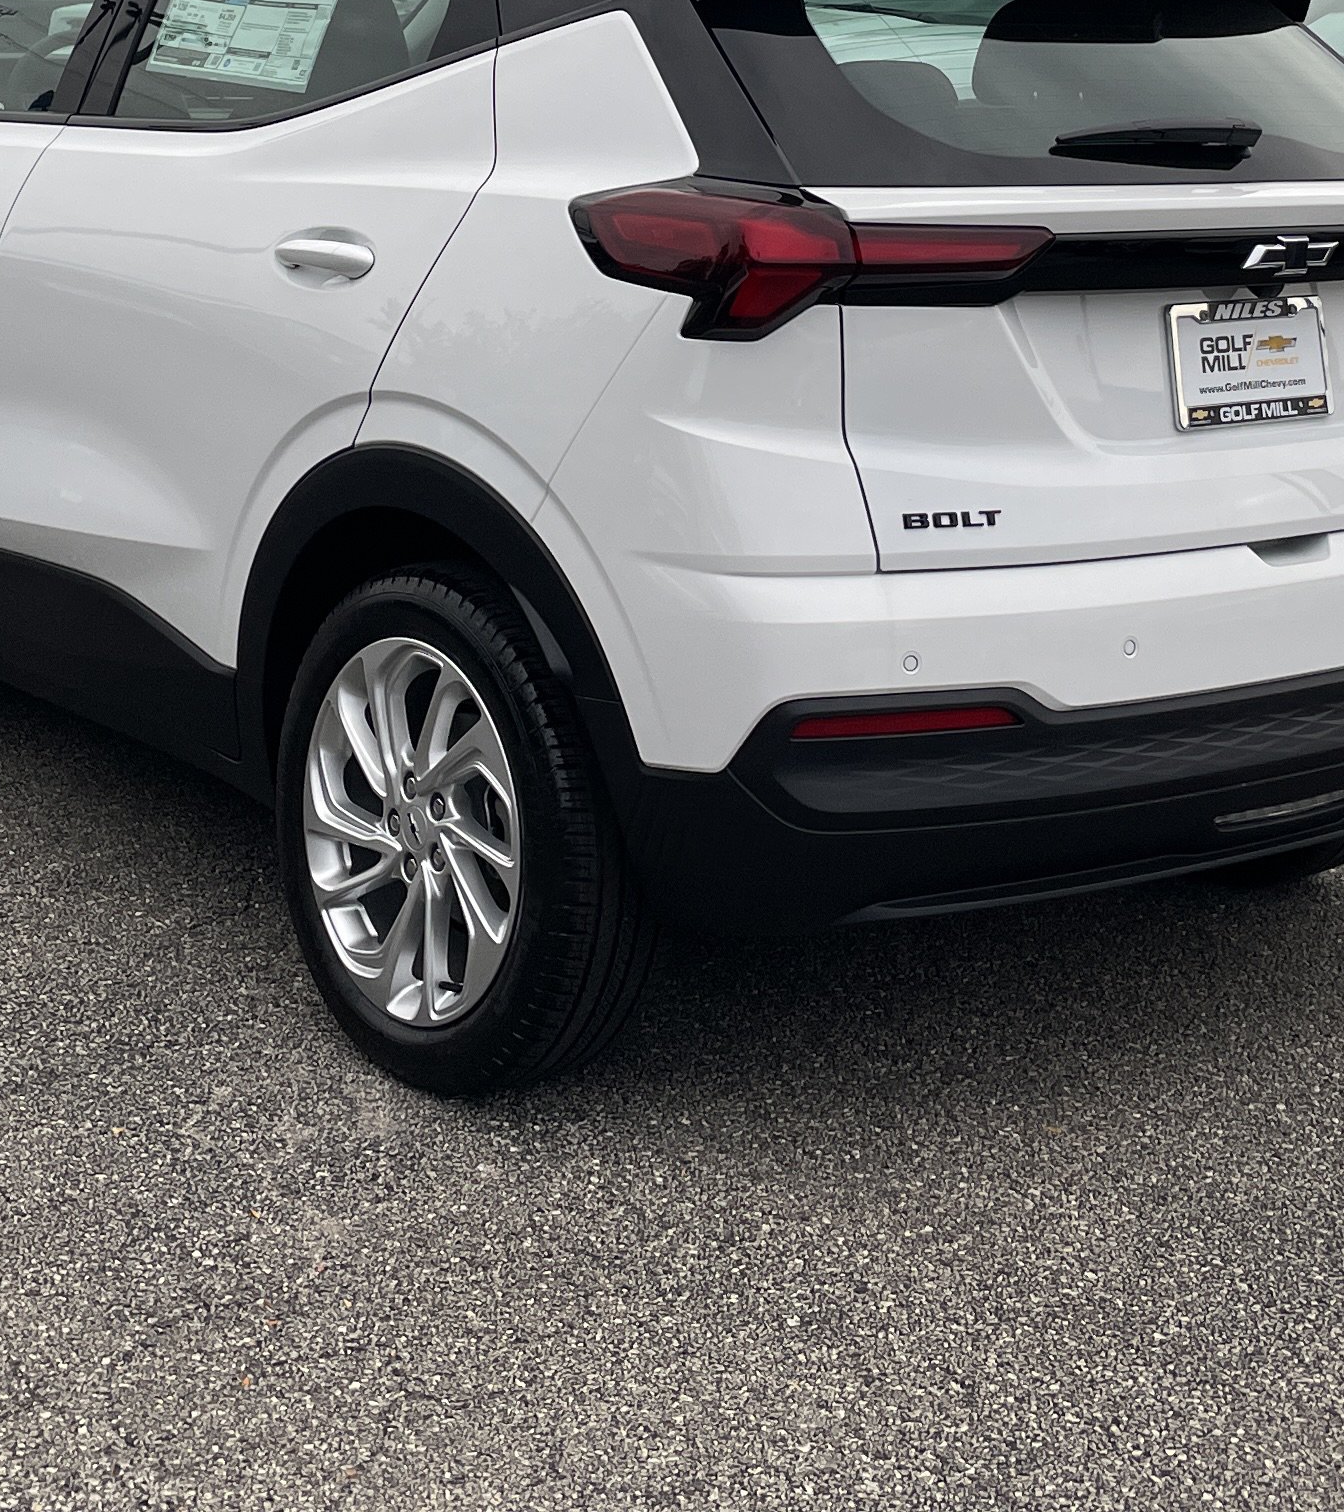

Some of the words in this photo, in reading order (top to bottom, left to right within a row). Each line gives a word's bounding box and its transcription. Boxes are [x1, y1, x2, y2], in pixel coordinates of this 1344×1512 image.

[1214, 300, 1283, 320] NILES
[1200, 334, 1253, 354] GOLF
[1202, 353, 1246, 373] MILL
[1256, 356, 1299, 367] CHEVROLET
[1199, 377, 1306, 394] www.GolfMillChevy.com
[1220, 403, 1260, 422] GOLF
[1261, 401, 1298, 418] MILL
[902, 510, 1001, 529] BOLT
